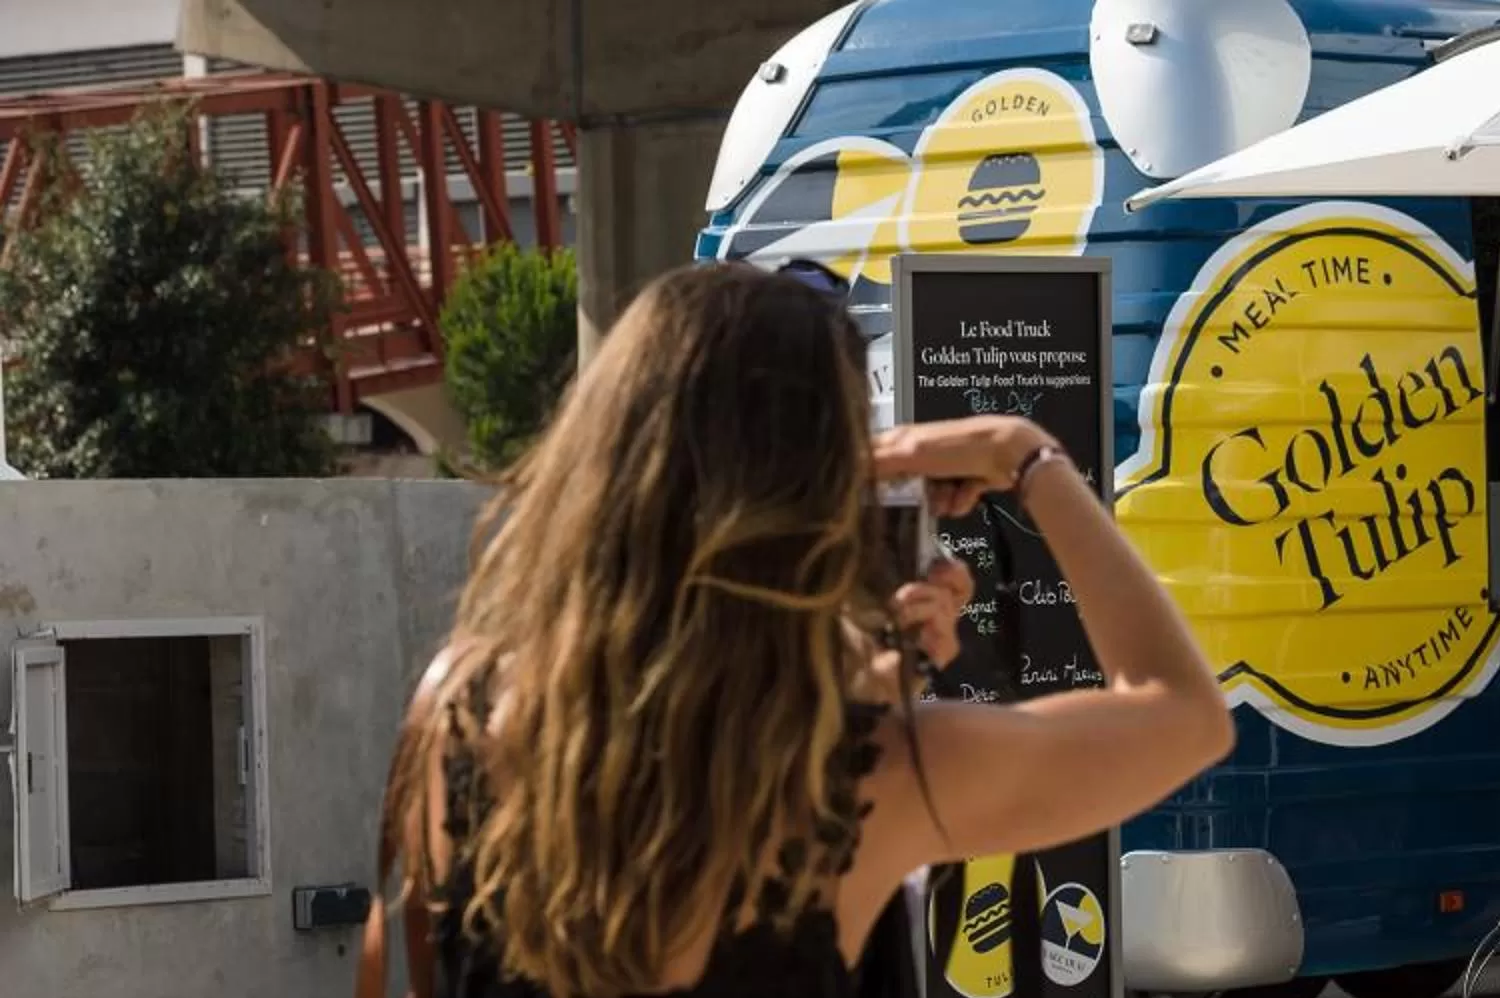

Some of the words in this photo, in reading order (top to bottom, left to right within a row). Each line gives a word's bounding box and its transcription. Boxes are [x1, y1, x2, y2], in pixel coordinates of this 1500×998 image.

[971, 93, 1051, 124] GOLDEN
[960, 321, 977, 337] Le
[980, 321, 1013, 337] Food
[1014, 319, 1051, 337] Truck
[1217, 280, 1298, 354] MEAL
[1302, 256, 1371, 286] TIME
[918, 375, 935, 388] The
[936, 374, 968, 388] Golden
[970, 374, 991, 388] Tulip
[993, 374, 1015, 387] Food
[1016, 373, 1044, 387] Truck's
[1045, 375, 1091, 389] suggestions
[921, 346, 971, 365] Golden
[972, 345, 1008, 369] Tulip
[1009, 350, 1037, 364] vous
[1039, 350, 1087, 369] propose
[1202, 345, 1484, 526] Golden
[1275, 463, 1475, 613] Tulip
[1364, 605, 1474, 689] ANYTIME
